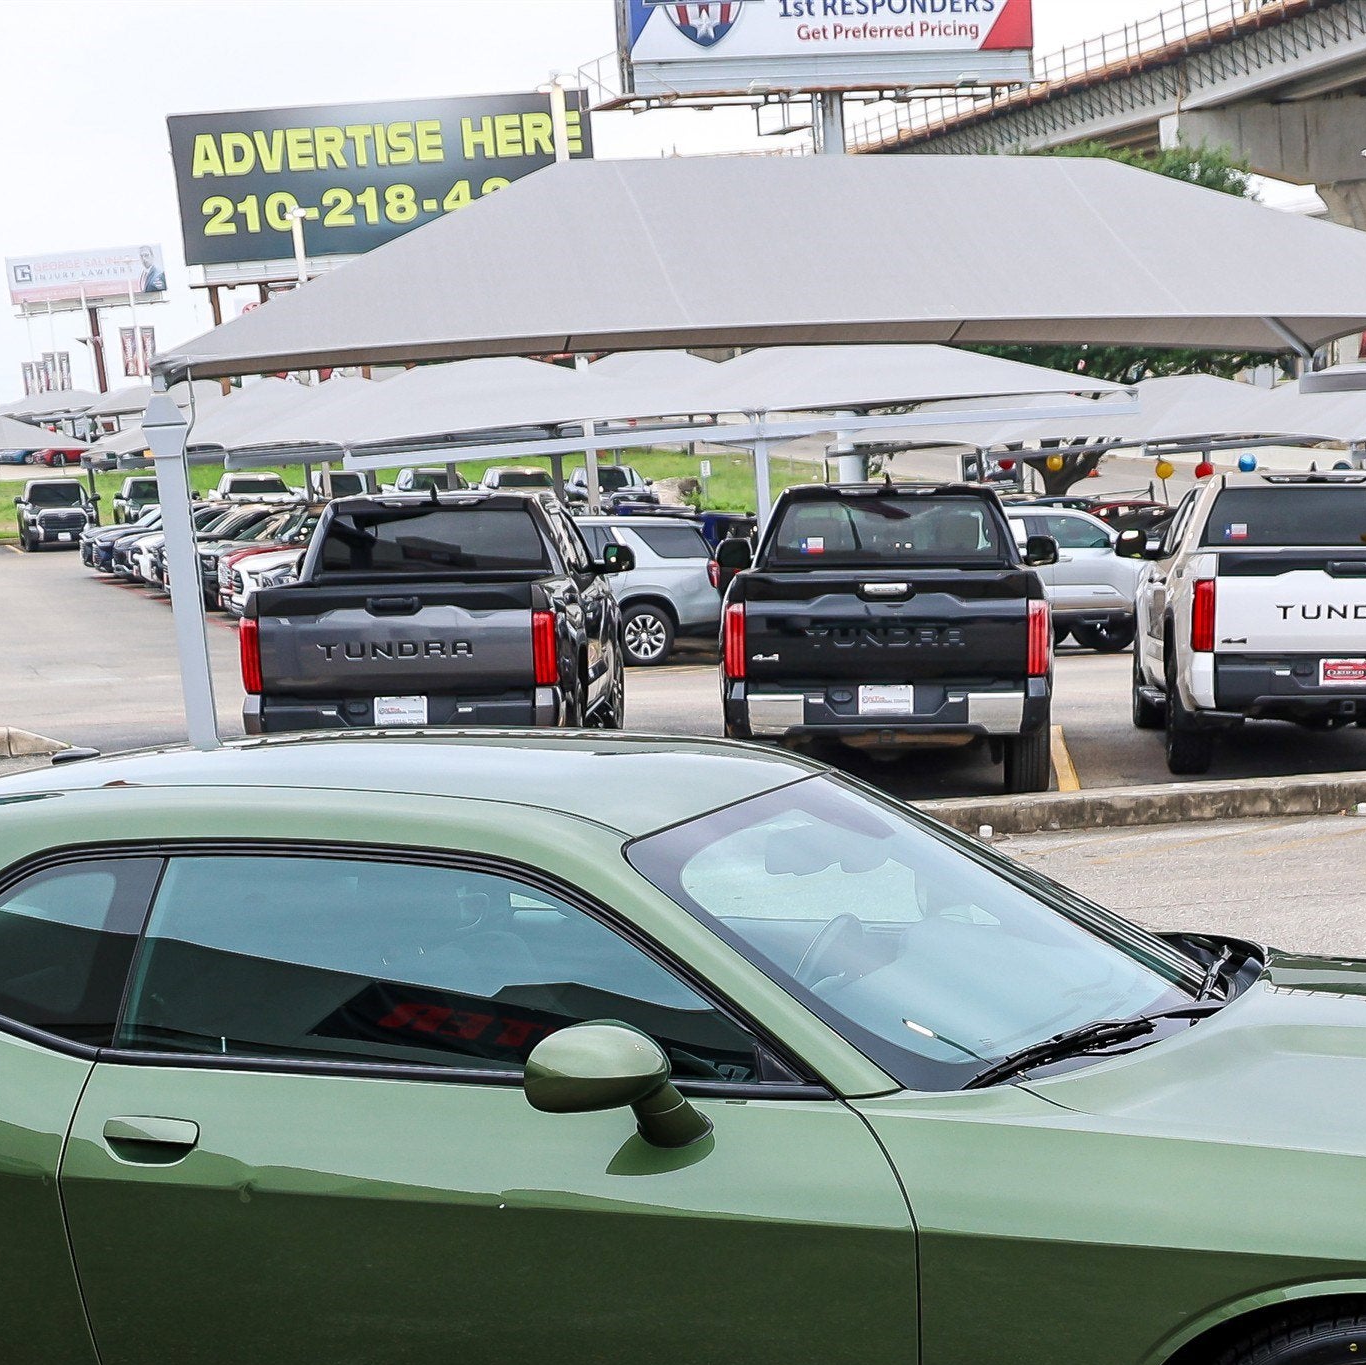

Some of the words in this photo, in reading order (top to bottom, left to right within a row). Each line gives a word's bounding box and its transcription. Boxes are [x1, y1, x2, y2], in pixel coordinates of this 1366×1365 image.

[779, 0, 815, 17] 1st
[823, 0, 995, 16] RESPONDERS
[797, 24, 829, 41] Get
[833, 22, 915, 40] Preferred
[919, 20, 980, 39] Pricing
[192, 119, 445, 178] ADVERTISE
[461, 110, 583, 160] HERE
[34, 261, 81, 272] GEORGE
[35, 272, 75, 282] INJURY
[805, 628, 966, 648] TUNDRA
[317, 639, 474, 661] TUNDRA
